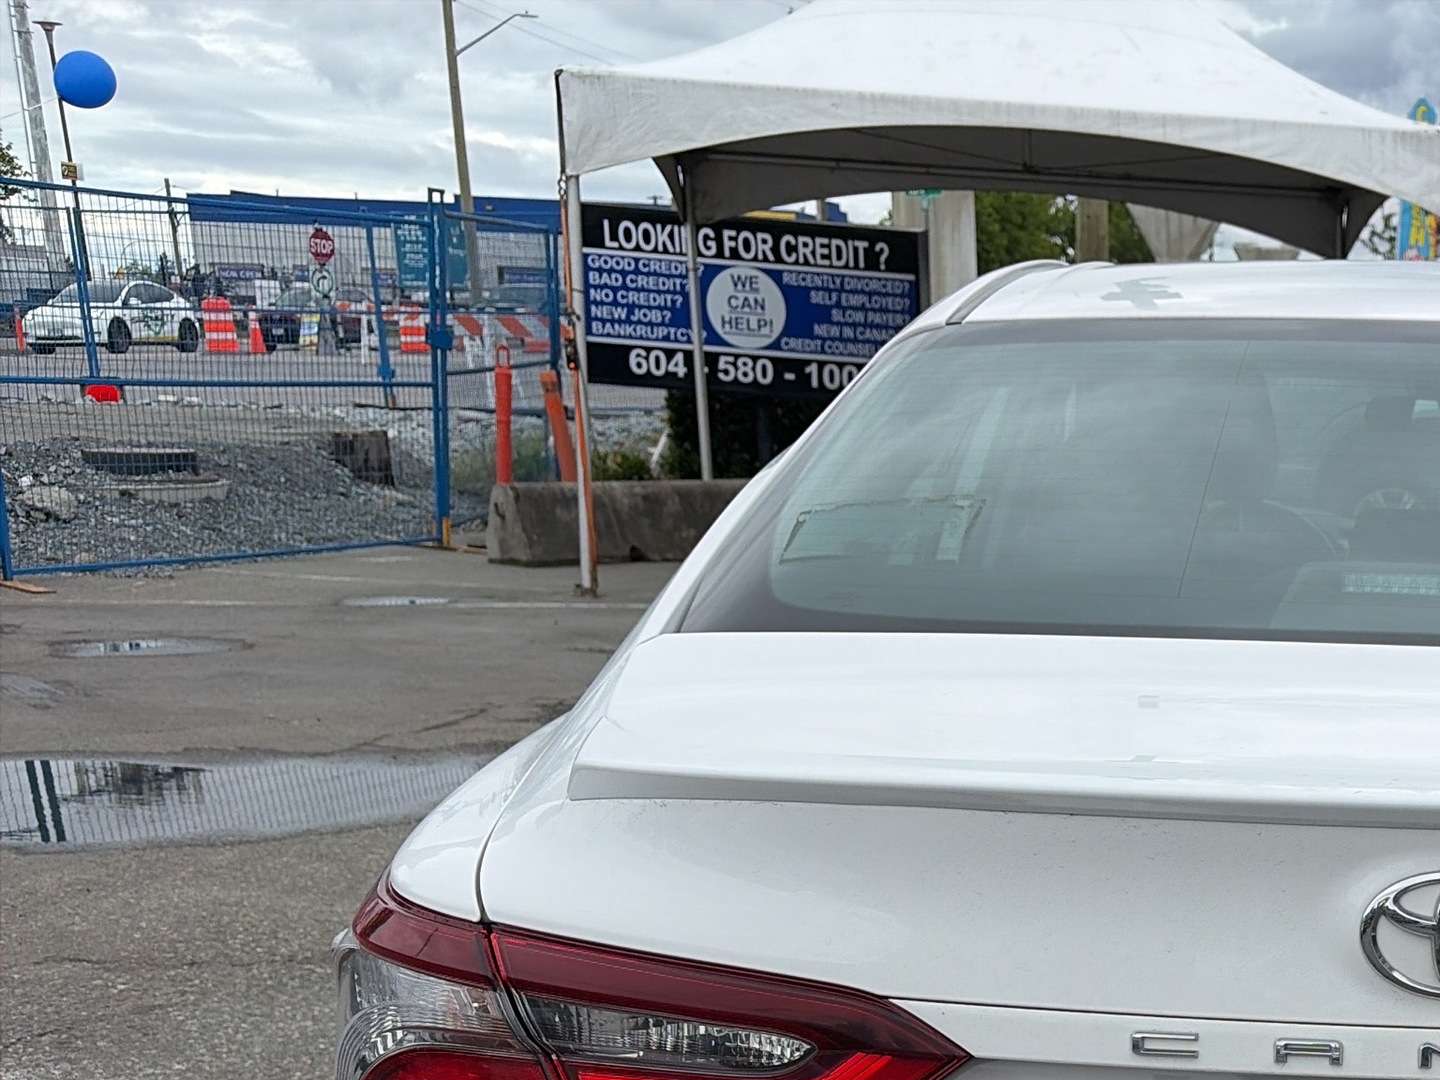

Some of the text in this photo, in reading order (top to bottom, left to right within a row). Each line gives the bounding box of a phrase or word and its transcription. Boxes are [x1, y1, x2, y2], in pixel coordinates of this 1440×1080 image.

[310, 238, 334, 255] STOP
[723, 229, 775, 262] FOR
[780, 234, 869, 269] CREDIT
[587, 254, 705, 276] GOOD CREDI?
[589, 271, 623, 287] BAD
[730, 273, 760, 290] WE
[782, 271, 911, 295] RECENTLY DIVORCED?
[590, 287, 684, 308] NO CREDIT?
[727, 295, 766, 312] CAN
[809, 290, 911, 310] SELF EMPLOYED?
[590, 305, 672, 324] NEW JOB?
[831, 308, 865, 324] SLOW
[721, 315, 774, 332] HELP!
[813, 323, 841, 338] NEW
[842, 325, 855, 340] IN
[780, 337, 822, 353] CREDIT
[629, 347, 688, 379] 604
[717, 356, 775, 386] 580
